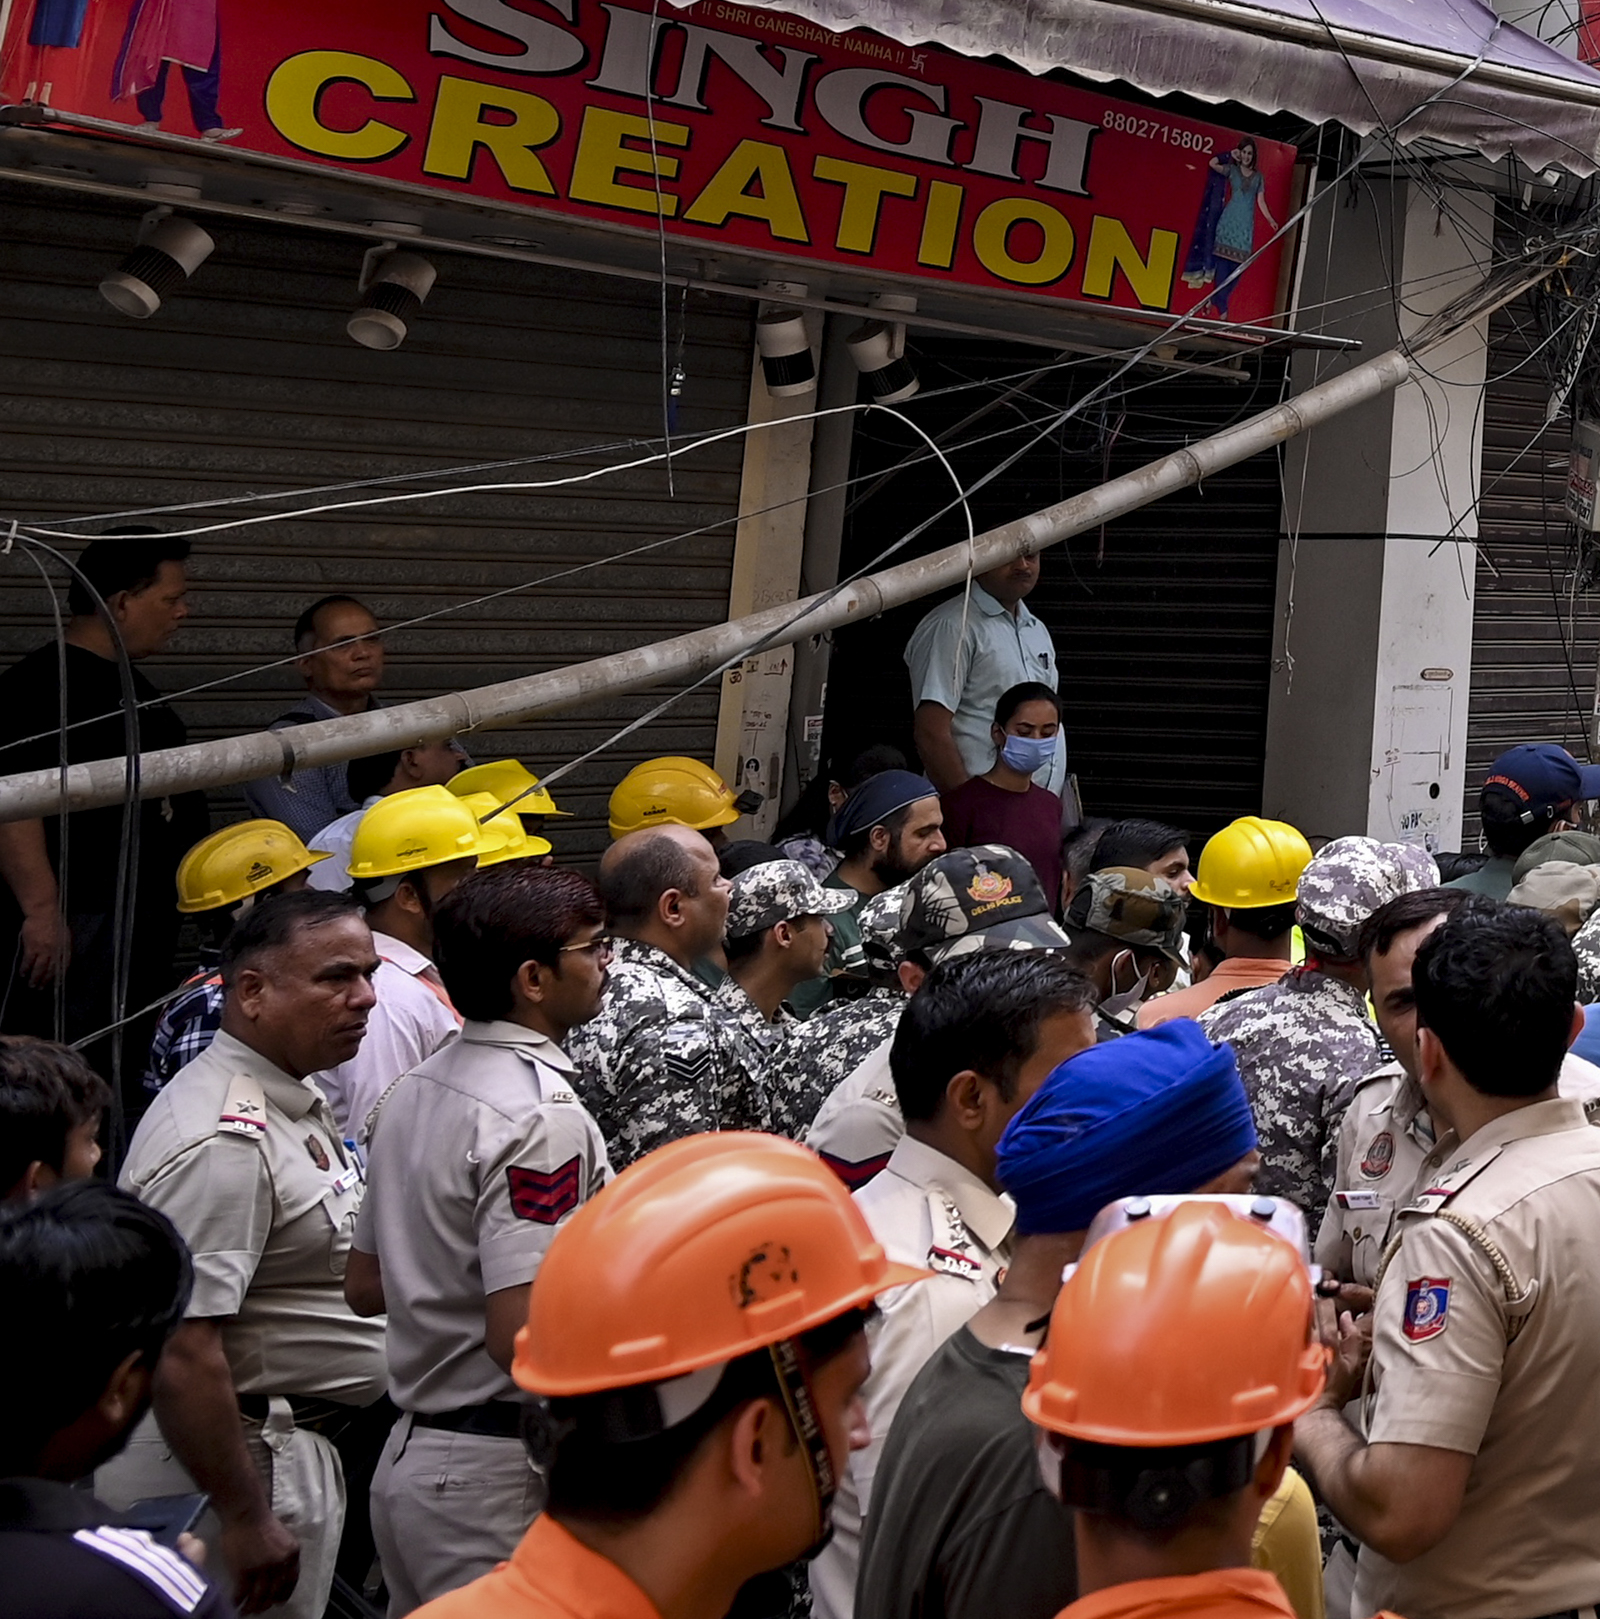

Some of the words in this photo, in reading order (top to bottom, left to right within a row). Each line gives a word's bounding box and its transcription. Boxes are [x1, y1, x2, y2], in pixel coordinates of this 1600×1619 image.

[715, 4, 751, 26] SHRI
[754, 14, 841, 47] GANESHAYE
[844, 36, 893, 62] NAMHA
[1102, 109, 1214, 157] 8802715802
[265, 51, 1179, 310] CREATION
[970, 901, 996, 917] DELHI
[995, 895, 1023, 907] POLICE
